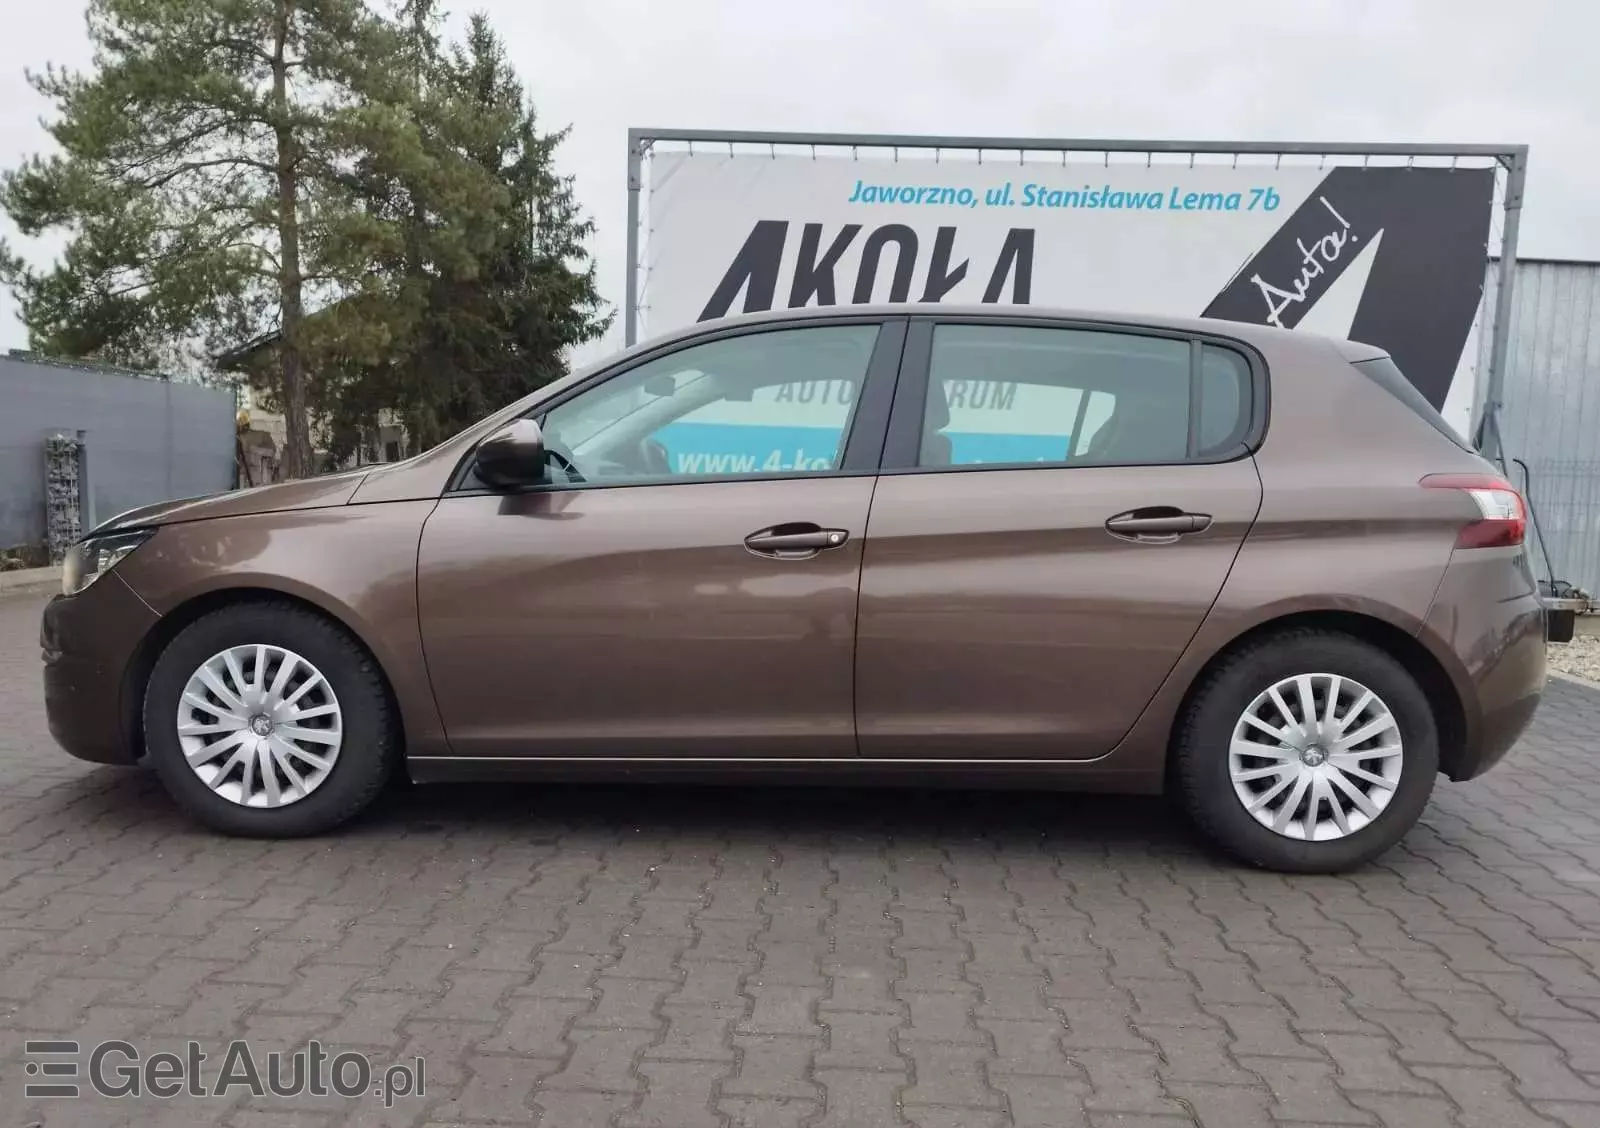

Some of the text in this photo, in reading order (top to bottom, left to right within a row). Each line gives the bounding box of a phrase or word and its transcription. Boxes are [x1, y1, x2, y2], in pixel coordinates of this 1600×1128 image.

[848, 180, 1281, 211] Jaworzno, ul. Stanisława Lema 7b
[677, 448, 838, 474] www.4-ko
